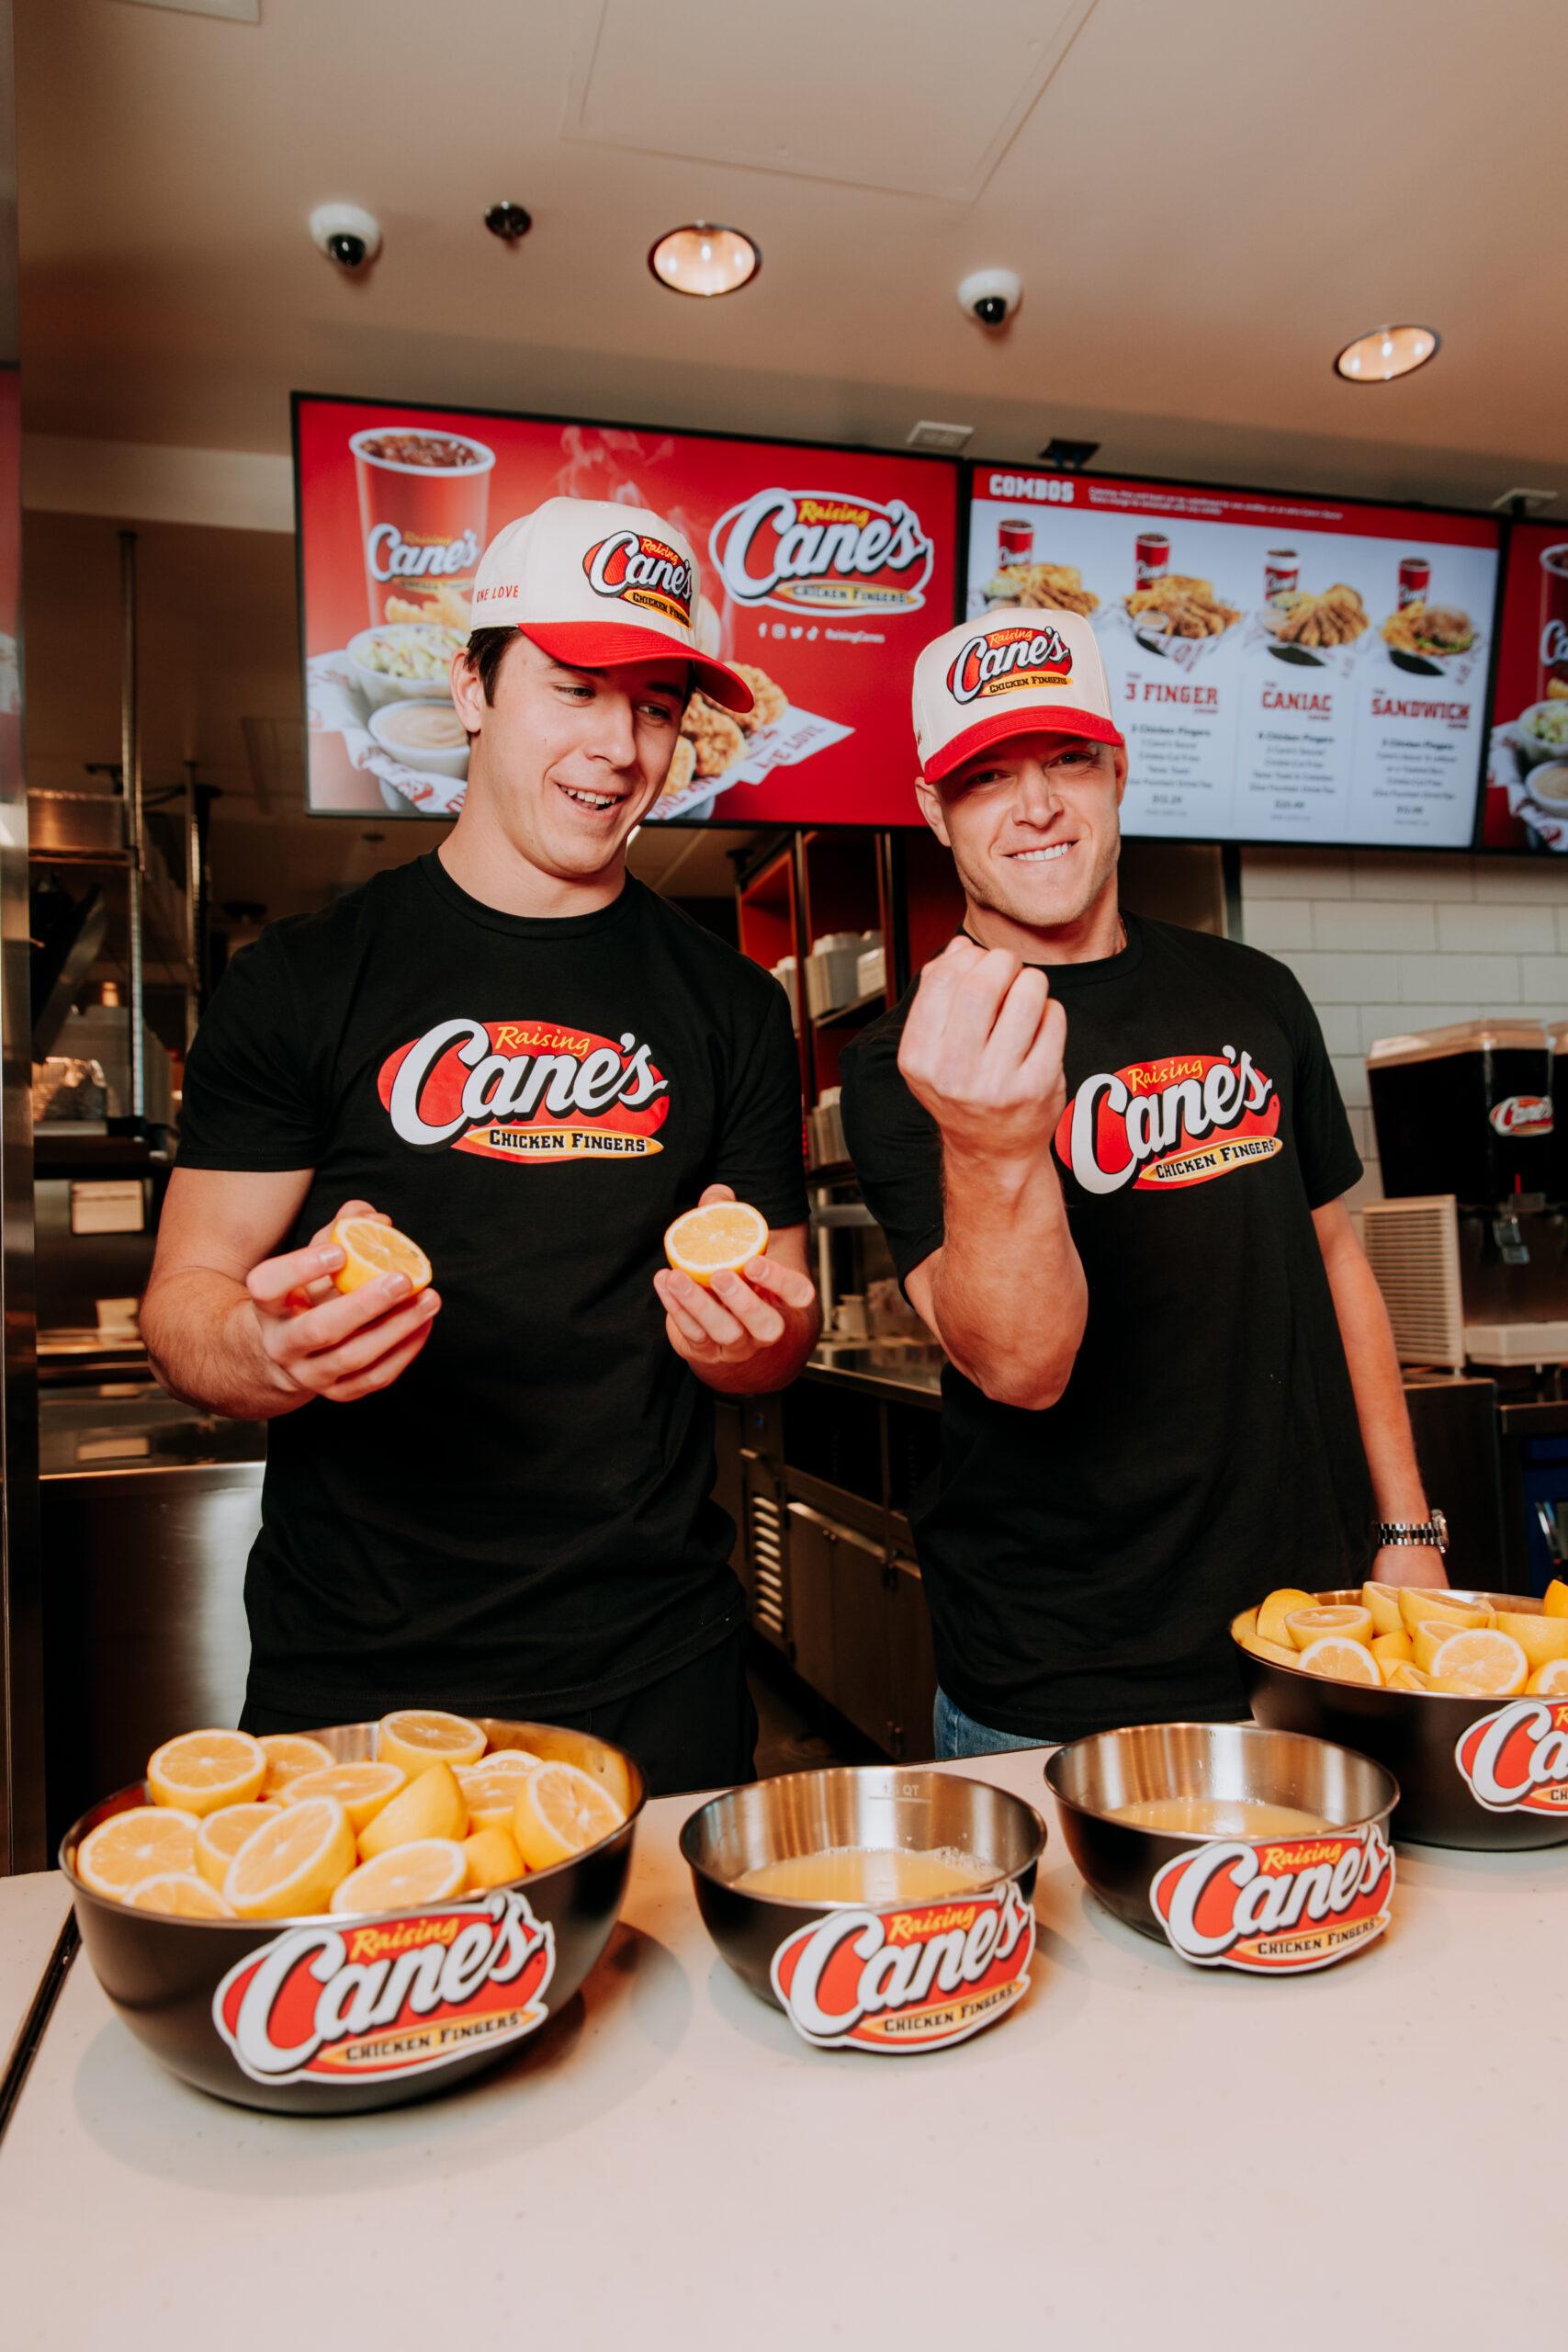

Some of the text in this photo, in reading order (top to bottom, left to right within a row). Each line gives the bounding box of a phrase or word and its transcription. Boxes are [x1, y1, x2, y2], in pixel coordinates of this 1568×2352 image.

[989, 474, 1074, 503] COMBOS
[797, 500, 871, 528] Raising
[369, 523, 480, 582] Cane's
[640, 537, 679, 566] Raising
[724, 492, 928, 598] Cane's
[590, 531, 692, 600] Cane's
[476, 588, 489, 603] ONE
[491, 584, 520, 599] LOVE
[989, 628, 1033, 646] Raising
[953, 627, 1069, 702] Cane's
[989, 675, 1067, 694] CHICKEN FINGERS
[1125, 684, 1219, 706] 3 FINGER
[1262, 691, 1332, 712] CANIAC
[1371, 697, 1471, 720] SANDWICH
[495, 1026, 591, 1057] Raising
[390, 1018, 669, 1145] Cane's
[1128, 1059, 1203, 1092] Raising
[1071, 1045, 1272, 1194] Cane's
[489, 1129, 646, 1152] CHICKEN FINGERS
[1156, 1139, 1275, 1180] CHICKEN FINGERS
[902, 1785, 919, 1796] QT
[1262, 1842, 1342, 1872] Raising
[1168, 1826, 1392, 1955] Cane's
[350, 1918, 459, 1962] Raising
[889, 1905, 976, 1941] Raising
[1257, 1921, 1375, 1955] CHICKEN FINGERS
[790, 1883, 1030, 2035] Cane's
[236, 1894, 546, 2073] Cane's
[884, 1986, 1014, 2032] CHICKEN FINGERS
[345, 2013, 520, 2061] CHICKEN FINGERS
